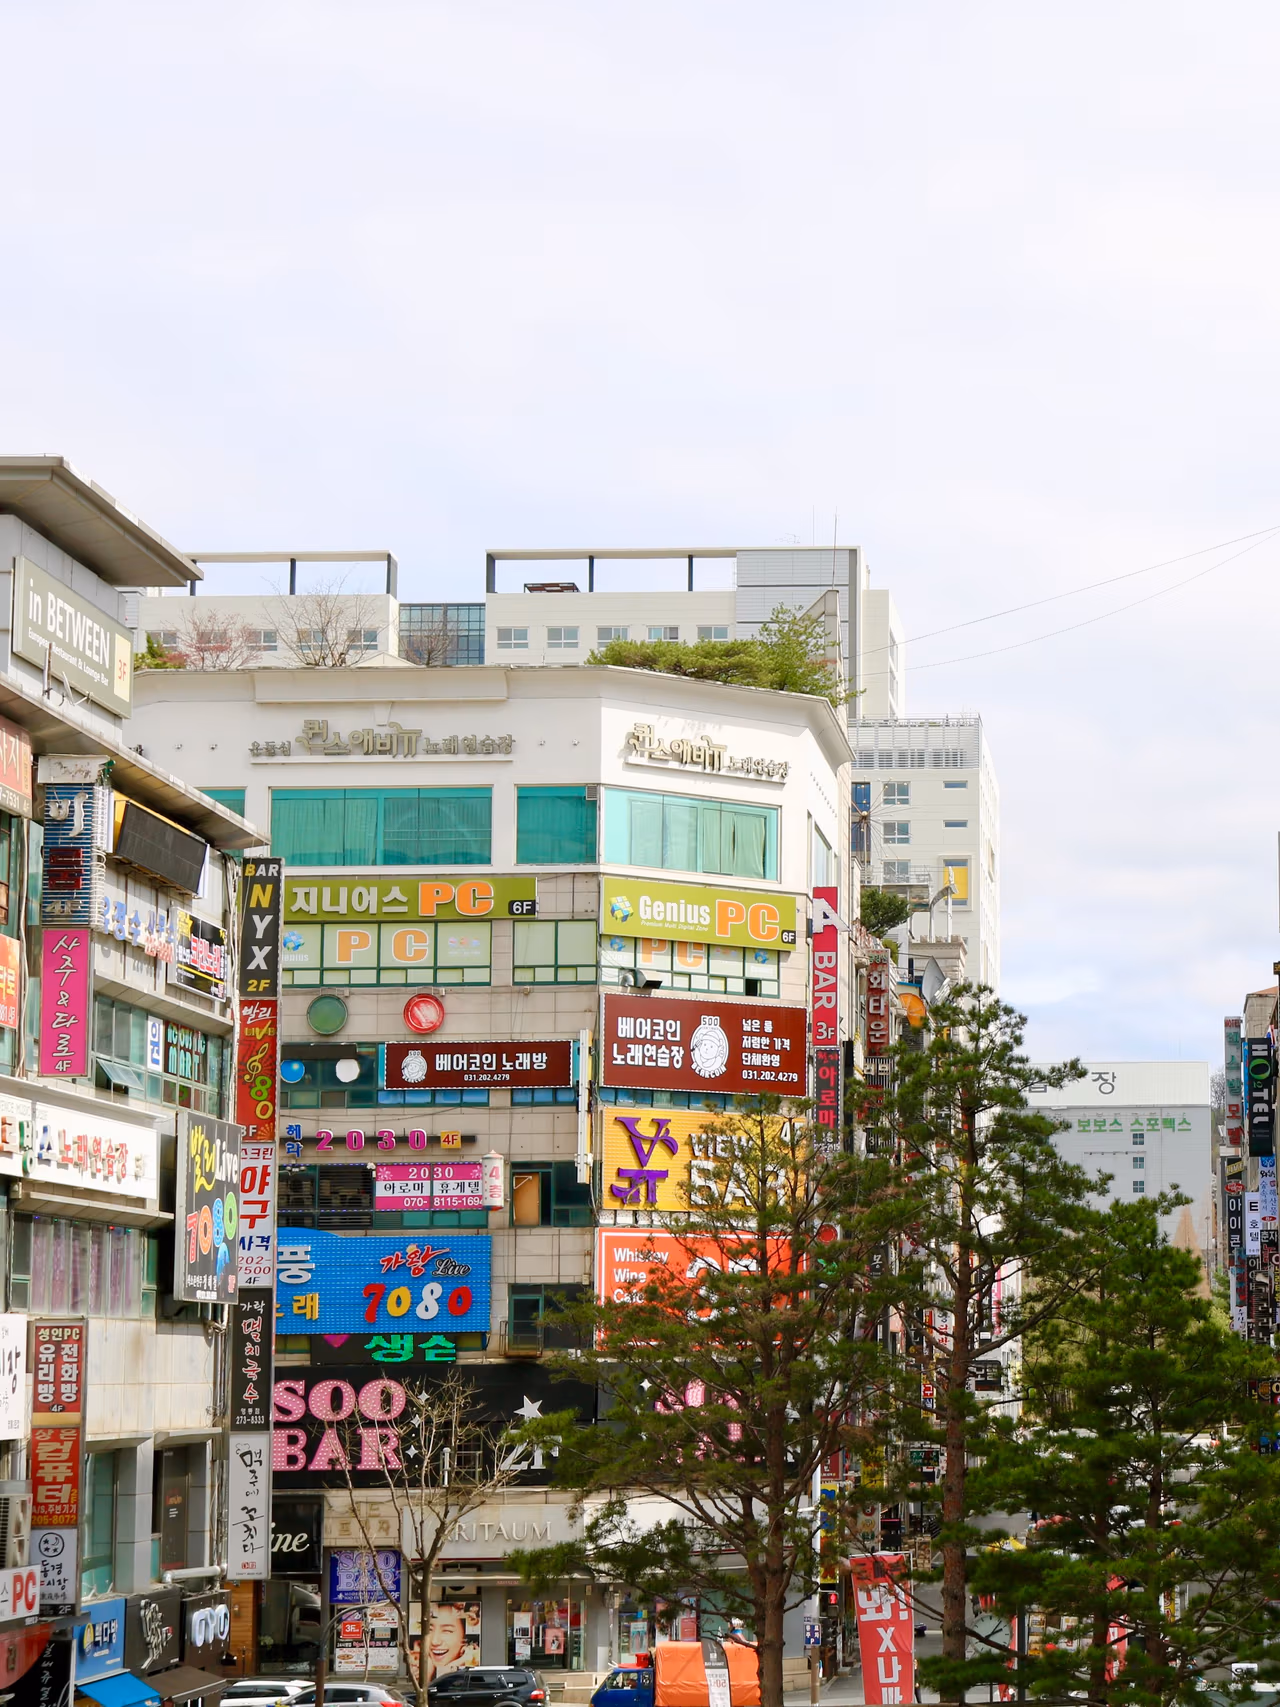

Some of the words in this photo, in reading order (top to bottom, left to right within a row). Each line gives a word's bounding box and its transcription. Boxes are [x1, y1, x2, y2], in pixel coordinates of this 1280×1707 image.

[29, 578, 42, 625] in
[47, 591, 110, 669] BETWEEN
[83, 661, 101, 683] Lounge
[100, 672, 109, 687] Bar
[117, 658, 128, 683] 3F
[422, 733, 516, 755] 노래연습장
[728, 755, 790, 778] 노래연습장
[245, 864, 279, 877] BAR
[290, 885, 409, 915] 지니어스
[418, 881, 494, 917] PC
[512, 901, 532, 914] 6F
[247, 884, 273, 971] NYX
[639, 895, 711, 925] Genius
[716, 898, 780, 942] PC
[782, 931, 796, 944] 6F
[336, 929, 429, 964] PC
[247, 980, 270, 992] 2F
[813, 951, 837, 1009] BAR
[242, 1002, 274, 1021] 발리
[701, 1016, 720, 1026] 500
[617, 1016, 681, 1042] 베어코인
[742, 1018, 761, 1033] 넓은
[764, 1020, 774, 1033] 룸
[816, 1022, 835, 1039] 3F
[742, 1035, 771, 1050] 저렴한
[773, 1037, 791, 1052] 가격
[56, 1060, 71, 1072] 4F
[436, 1053, 497, 1072] 베어코인
[502, 1052, 548, 1070] 노래방
[612, 1043, 685, 1069] 노래연습장
[742, 1053, 781, 1067] 단체환영
[464, 1073, 510, 1082] 031.202.4279
[742, 1069, 798, 1083] 031.202.4279
[818, 1065, 837, 1130] 아로마
[1077, 1118, 1124, 1133] 보보스
[1130, 1117, 1192, 1133] 스포렉스
[316, 1128, 427, 1151] 2030
[441, 1134, 459, 1146] 4F
[61, 1128, 129, 1179] 노래연습장
[215, 1131, 239, 1185] Live
[408, 1166, 454, 1179] 2030
[241, 1165, 272, 1229] 야구
[383, 1181, 425, 1195] 아로마
[438, 1180, 480, 1195] 휴게텔
[187, 1191, 237, 1264] 7080
[614, 1247, 669, 1264] Whiskey
[432, 1257, 471, 1277] Live
[614, 1268, 647, 1284] Wine
[245, 1276, 260, 1285] 4F
[240, 1300, 266, 1313] 가락
[362, 1282, 472, 1323] 7080
[37, 1328, 80, 1341] 성인PC
[37, 1343, 56, 1403] 유리방
[60, 1343, 79, 1403] 전화방
[51, 1404, 63, 1413] 4F
[272, 1379, 406, 1423] SOO
[236, 1416, 265, 1425] 273-8333
[272, 1428, 403, 1471] BAR
[36, 1442, 74, 1504] 컴퓨터
[31, 1514, 77, 1525] 205-8072
[11, 1570, 37, 1616] PC
[59, 1605, 72, 1614] 2F
[345, 1624, 355, 1632] 3F
